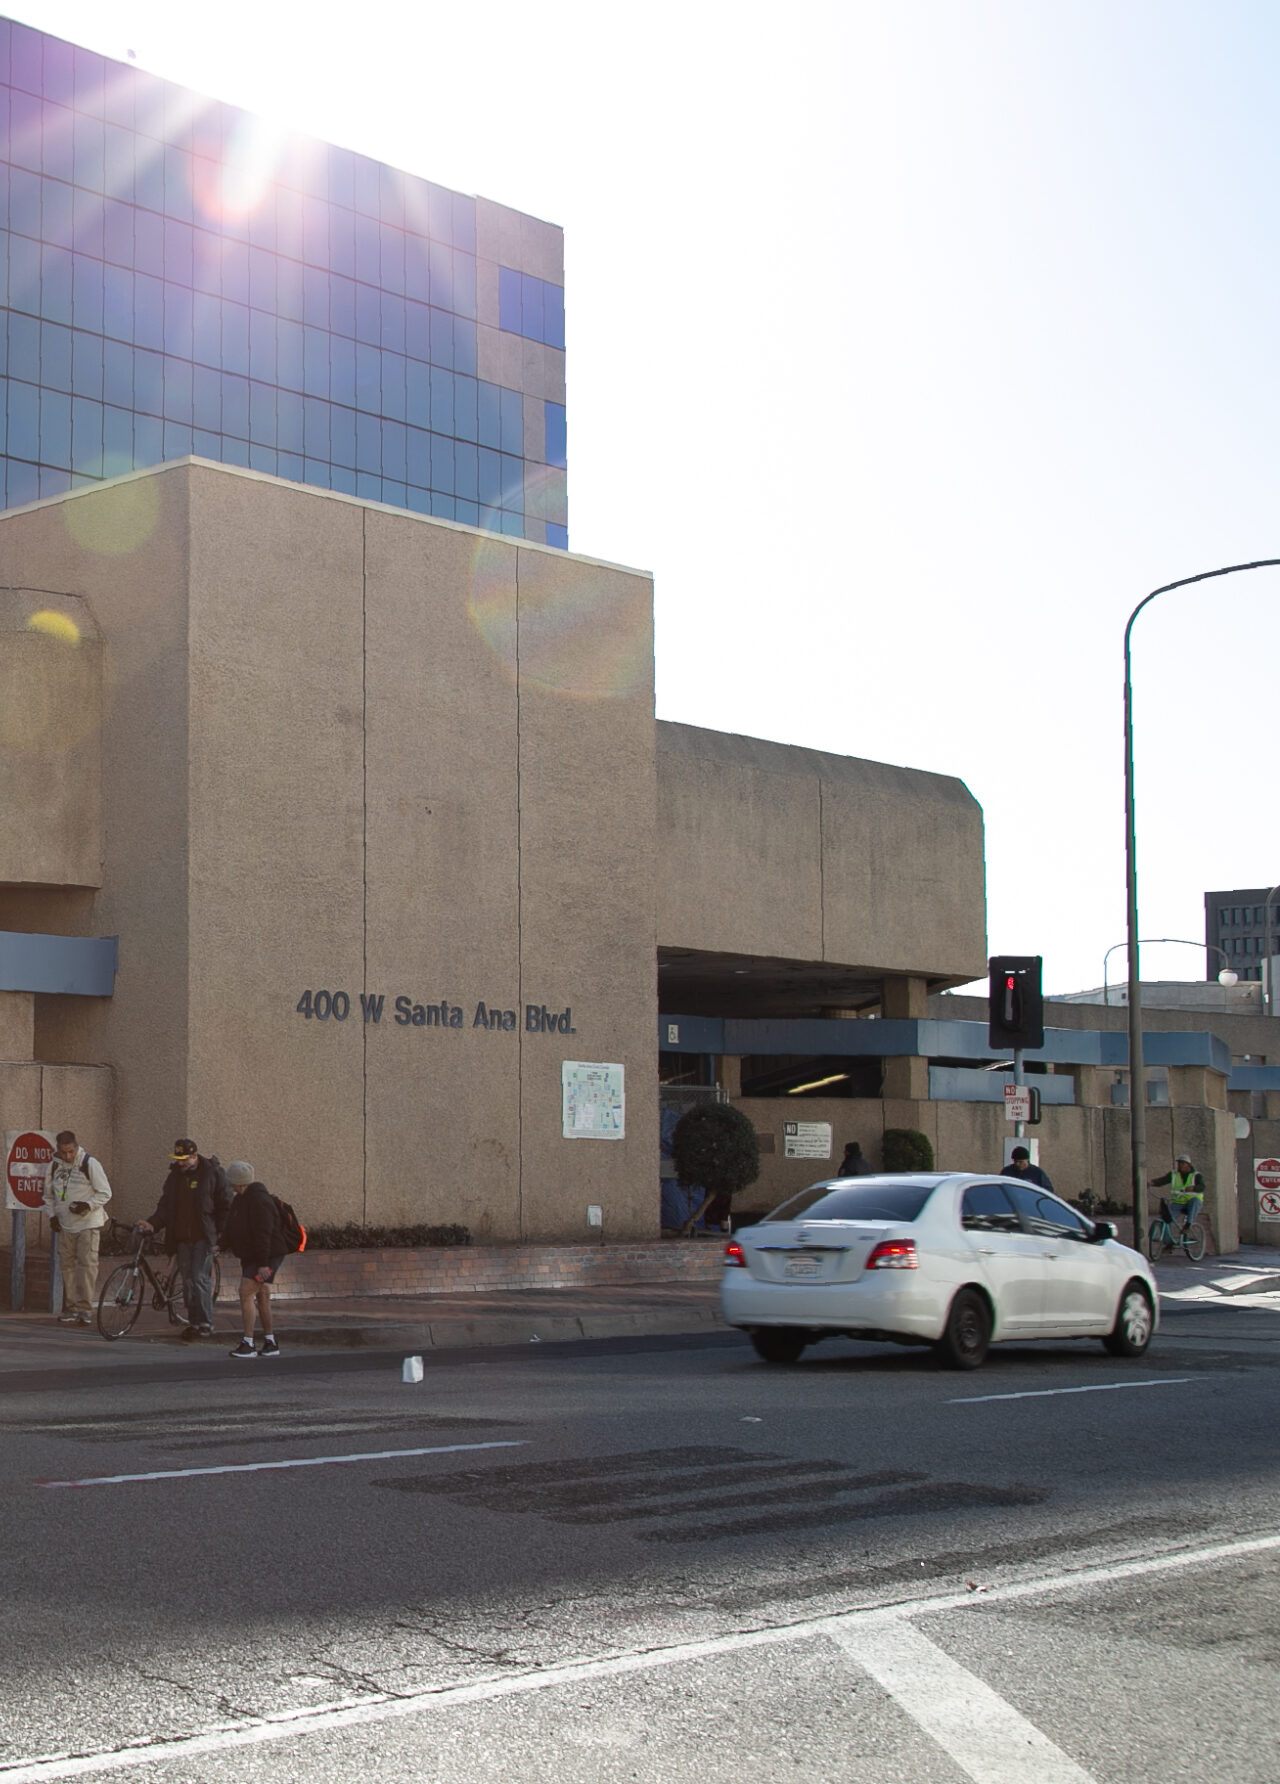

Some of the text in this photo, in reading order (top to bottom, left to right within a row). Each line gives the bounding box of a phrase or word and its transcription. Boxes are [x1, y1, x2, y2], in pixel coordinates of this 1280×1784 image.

[296, 989, 577, 1034] 400 W Santa Ana Blvd.
[1005, 1086, 1015, 1095] NO
[1006, 1096, 1029, 1104] STOPPING
[786, 1124, 796, 1134] NO
[15, 1146, 29, 1160] DO
[17, 1179, 43, 1193] ENTE
